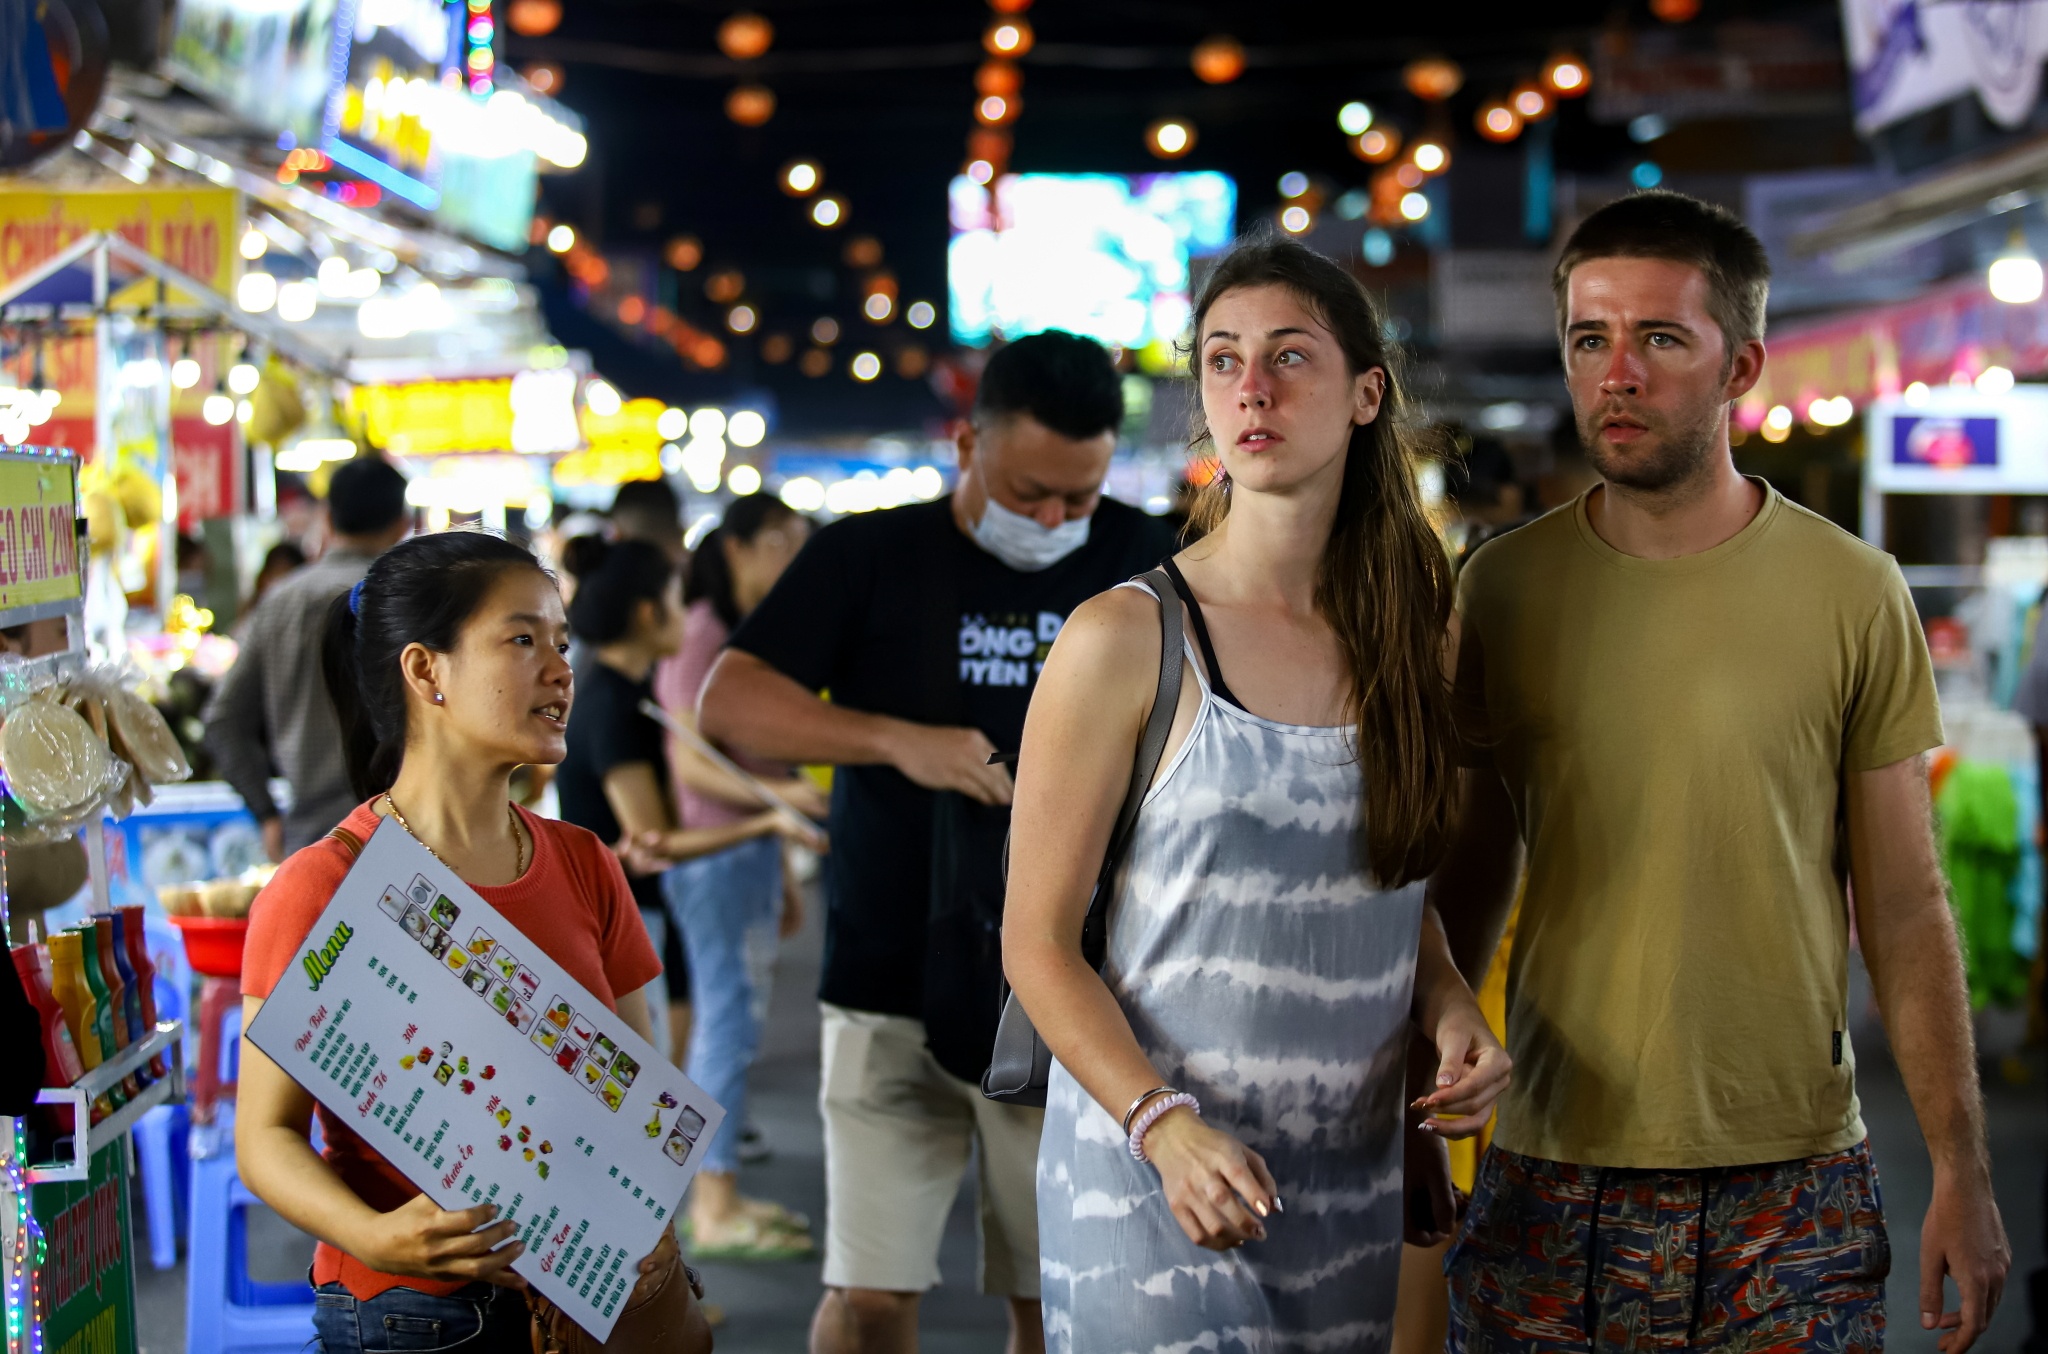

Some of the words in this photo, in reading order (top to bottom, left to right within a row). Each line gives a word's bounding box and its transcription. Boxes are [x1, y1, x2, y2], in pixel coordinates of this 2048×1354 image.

[300, 918, 354, 992] Menu
[368, 956, 379, 969] 50K
[319, 1056, 331, 1072] KEM
[377, 964, 389, 978] 50K
[329, 1065, 341, 1080] KEM
[386, 973, 398, 989] 150K
[407, 990, 417, 1004] 20K
[339, 1072, 352, 1089] SINH
[356, 1089, 377, 1118] Sinh
[400, 1021, 419, 1045] 30k
[484, 1092, 502, 1117] 30k
[413, 1135, 425, 1152] KIWI
[550, 1221, 571, 1250] Kem
[554, 1261, 566, 1278] KEM
[578, 1217, 590, 1233] LAN
[565, 1271, 579, 1288] KEM
[620, 1174, 631, 1189] 50K
[577, 1281, 591, 1299] KEM
[632, 1184, 643, 1199] 50K
[590, 1291, 603, 1309] KEM
[644, 1195, 655, 1210] 70K
[601, 1301, 614, 1318] KEM
[653, 1204, 666, 1221] 150K
